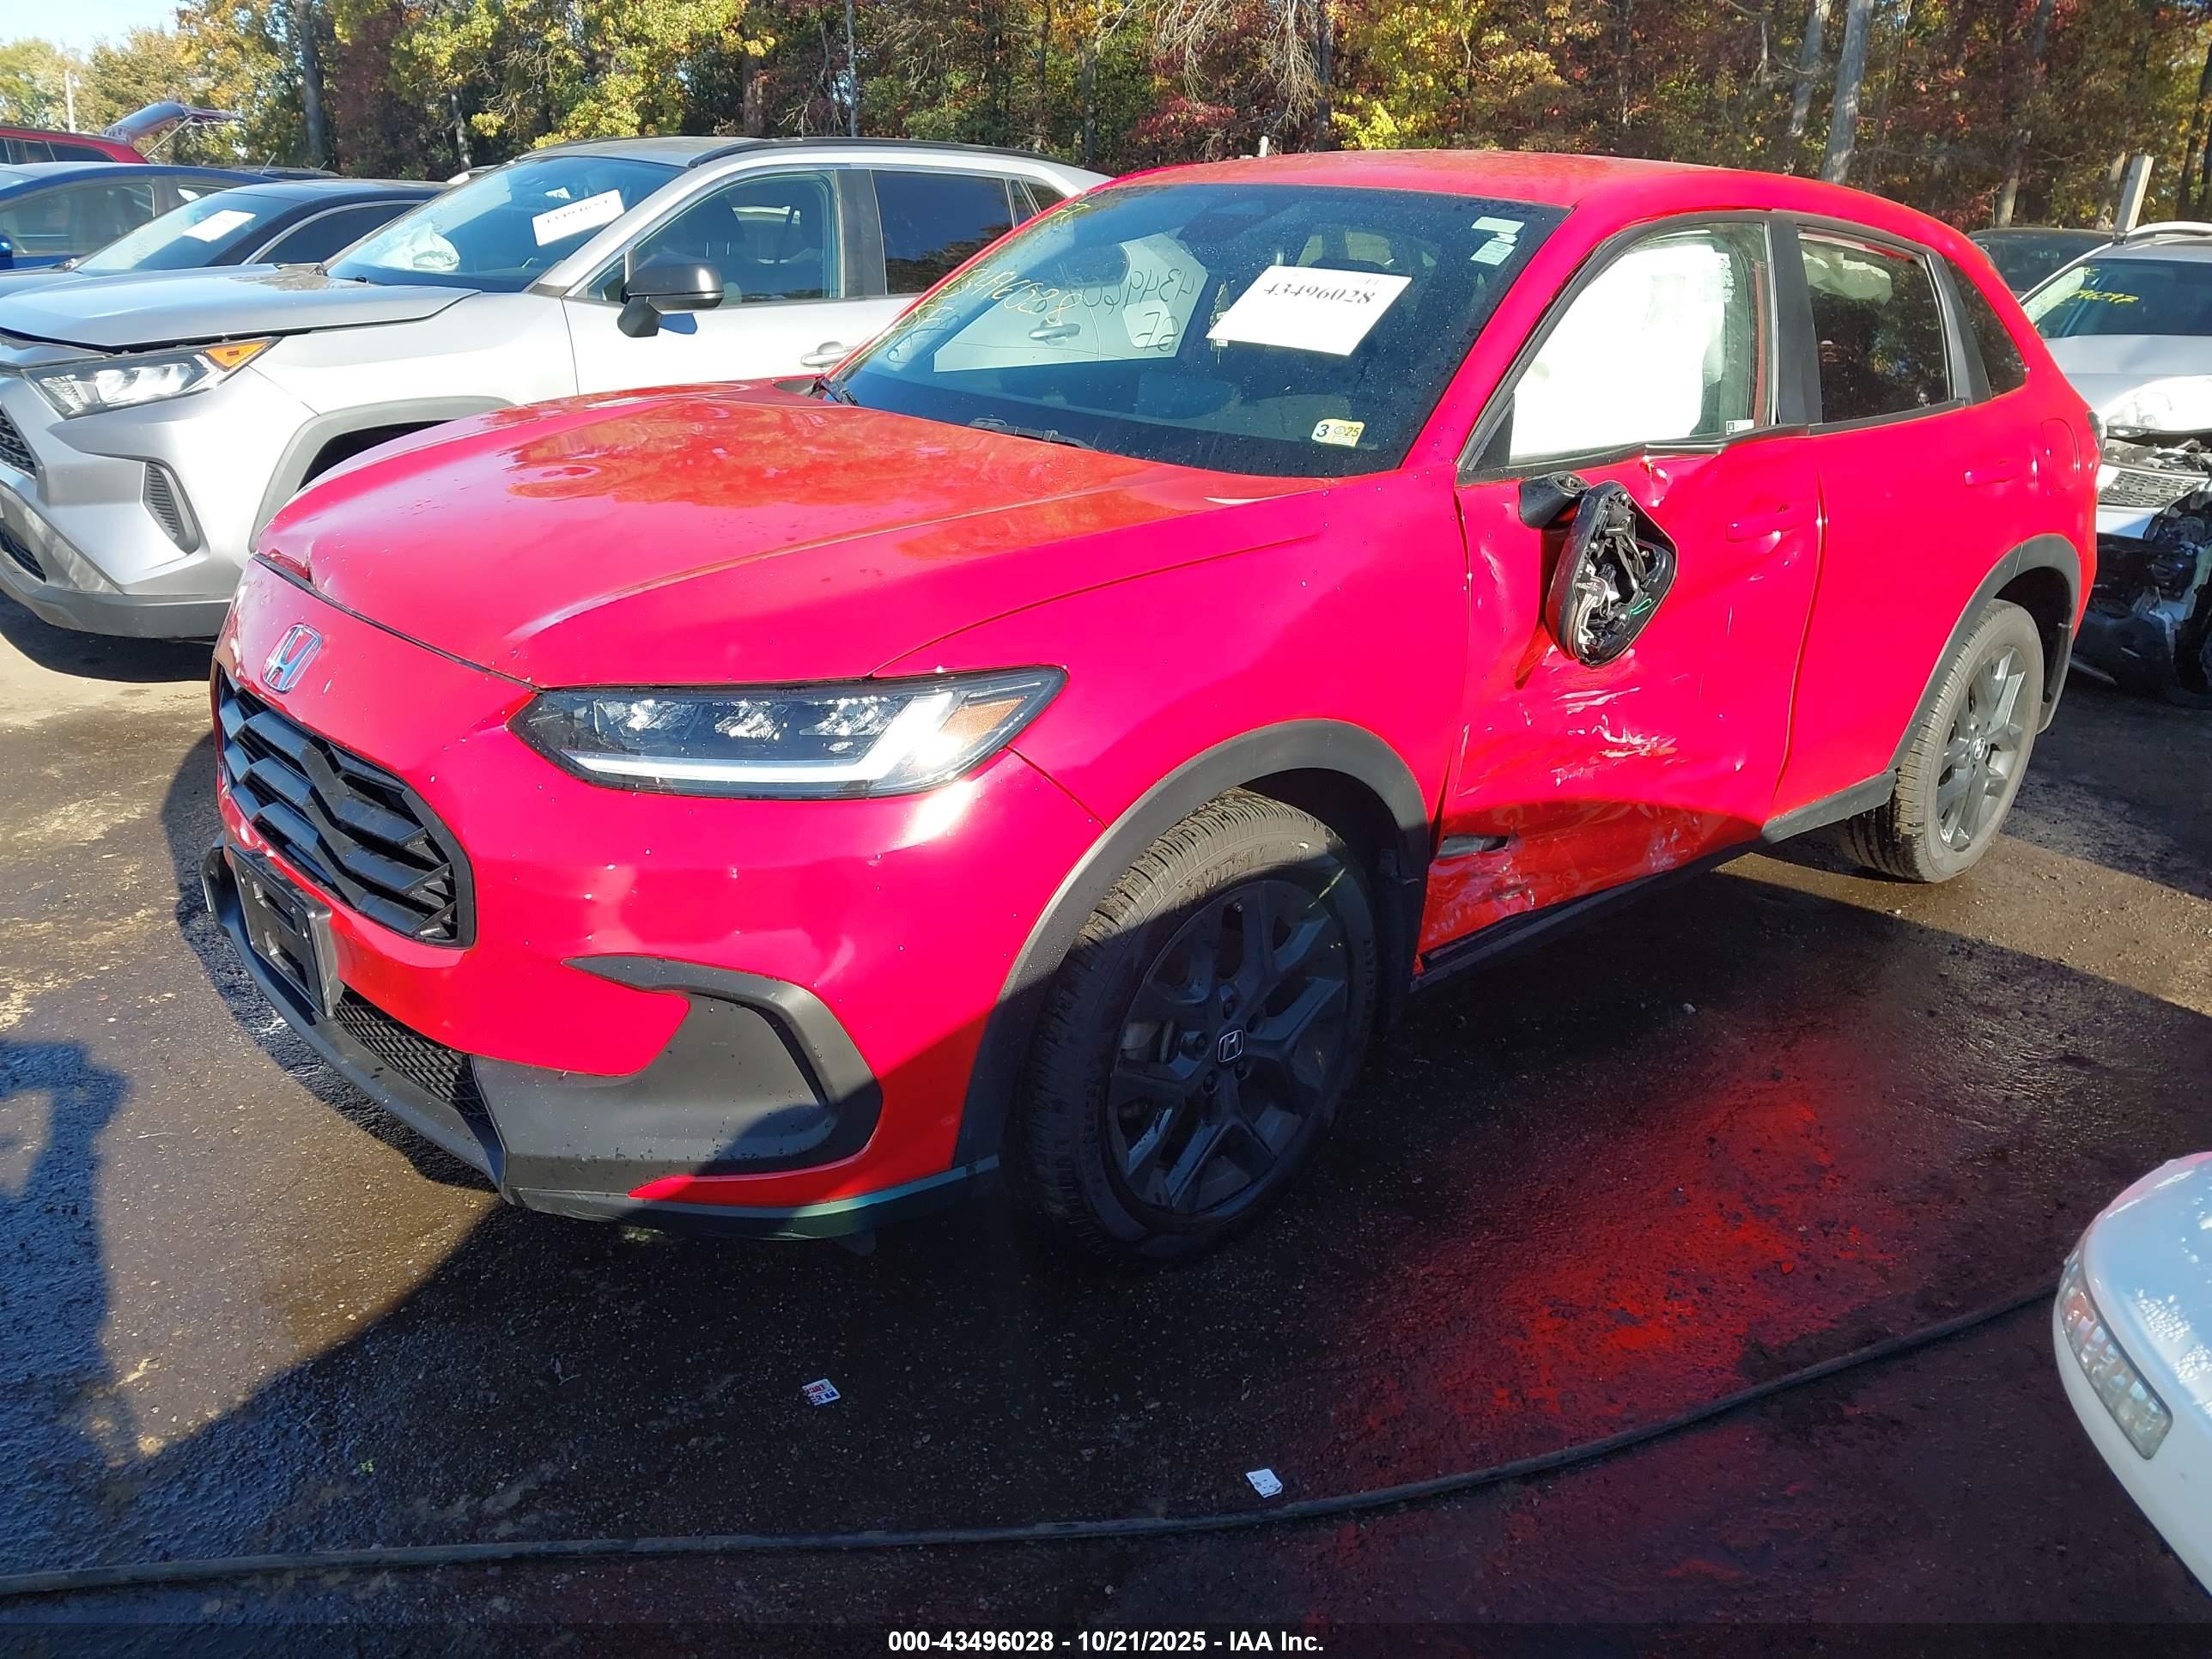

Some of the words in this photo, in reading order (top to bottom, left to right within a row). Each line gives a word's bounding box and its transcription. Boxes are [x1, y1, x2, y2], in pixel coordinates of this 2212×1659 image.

[1263, 282, 1377, 305] 43496028
[1316, 423, 1330, 438] 3
[1344, 426, 1361, 438] 25
